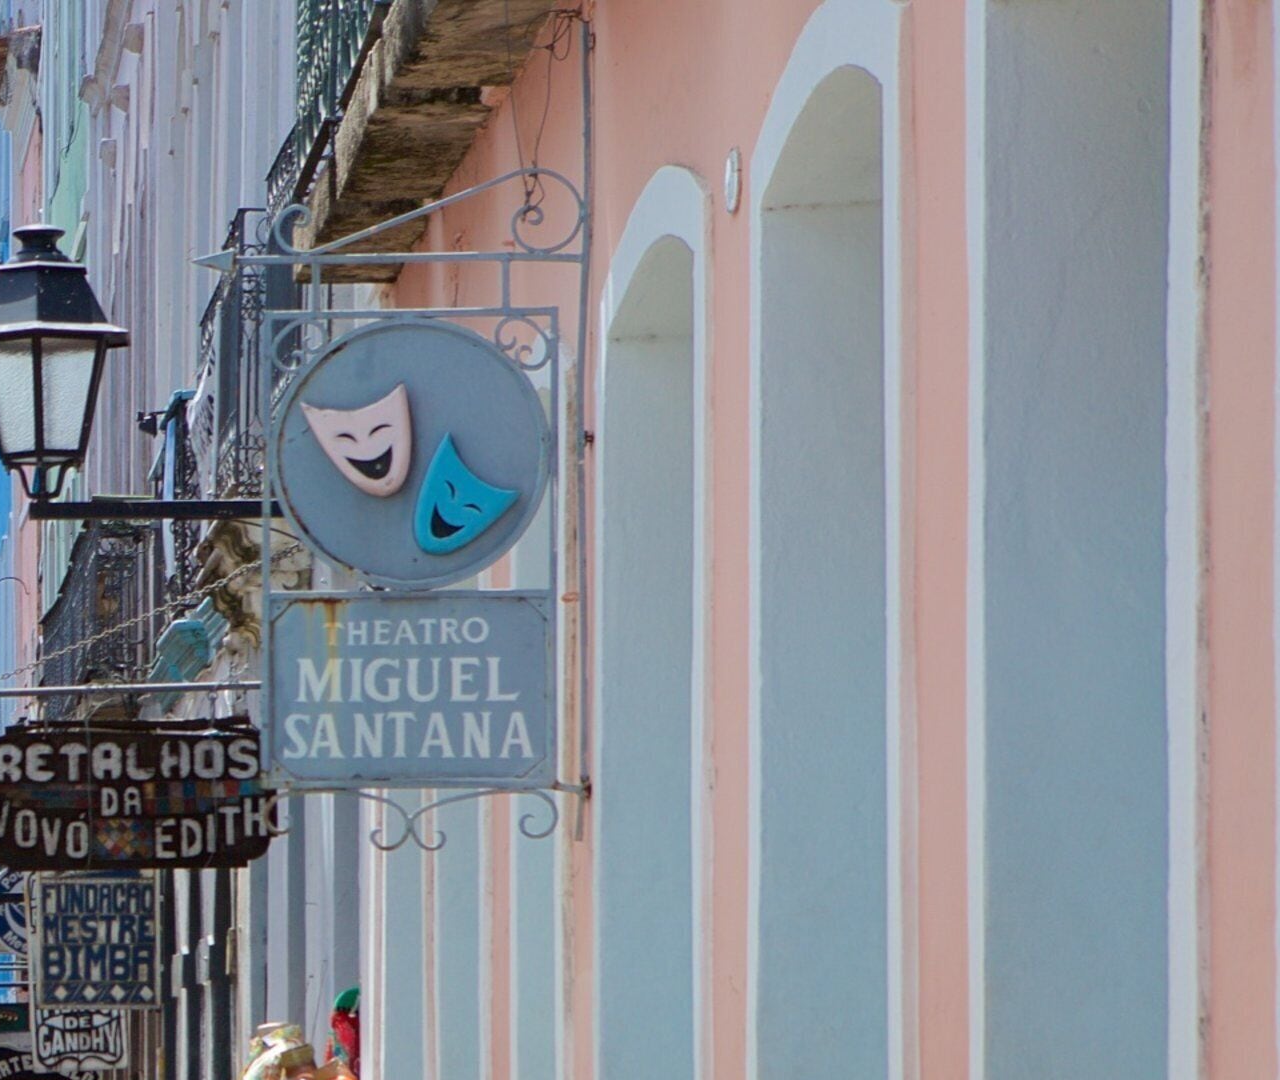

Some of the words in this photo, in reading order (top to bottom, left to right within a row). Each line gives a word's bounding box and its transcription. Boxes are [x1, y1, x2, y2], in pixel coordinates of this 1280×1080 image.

[324, 617, 489, 645] THEATRO
[297, 657, 521, 703] MIGUEL
[283, 712, 535, 758] SANTANA
[100, 787, 141, 817] DA
[155, 798, 267, 859] EDITH
[42, 914, 157, 943] MESTRE
[43, 944, 156, 981] BIMBA
[38, 1021, 118, 1059] GANDHY
[65, 1016, 91, 1030] DE
